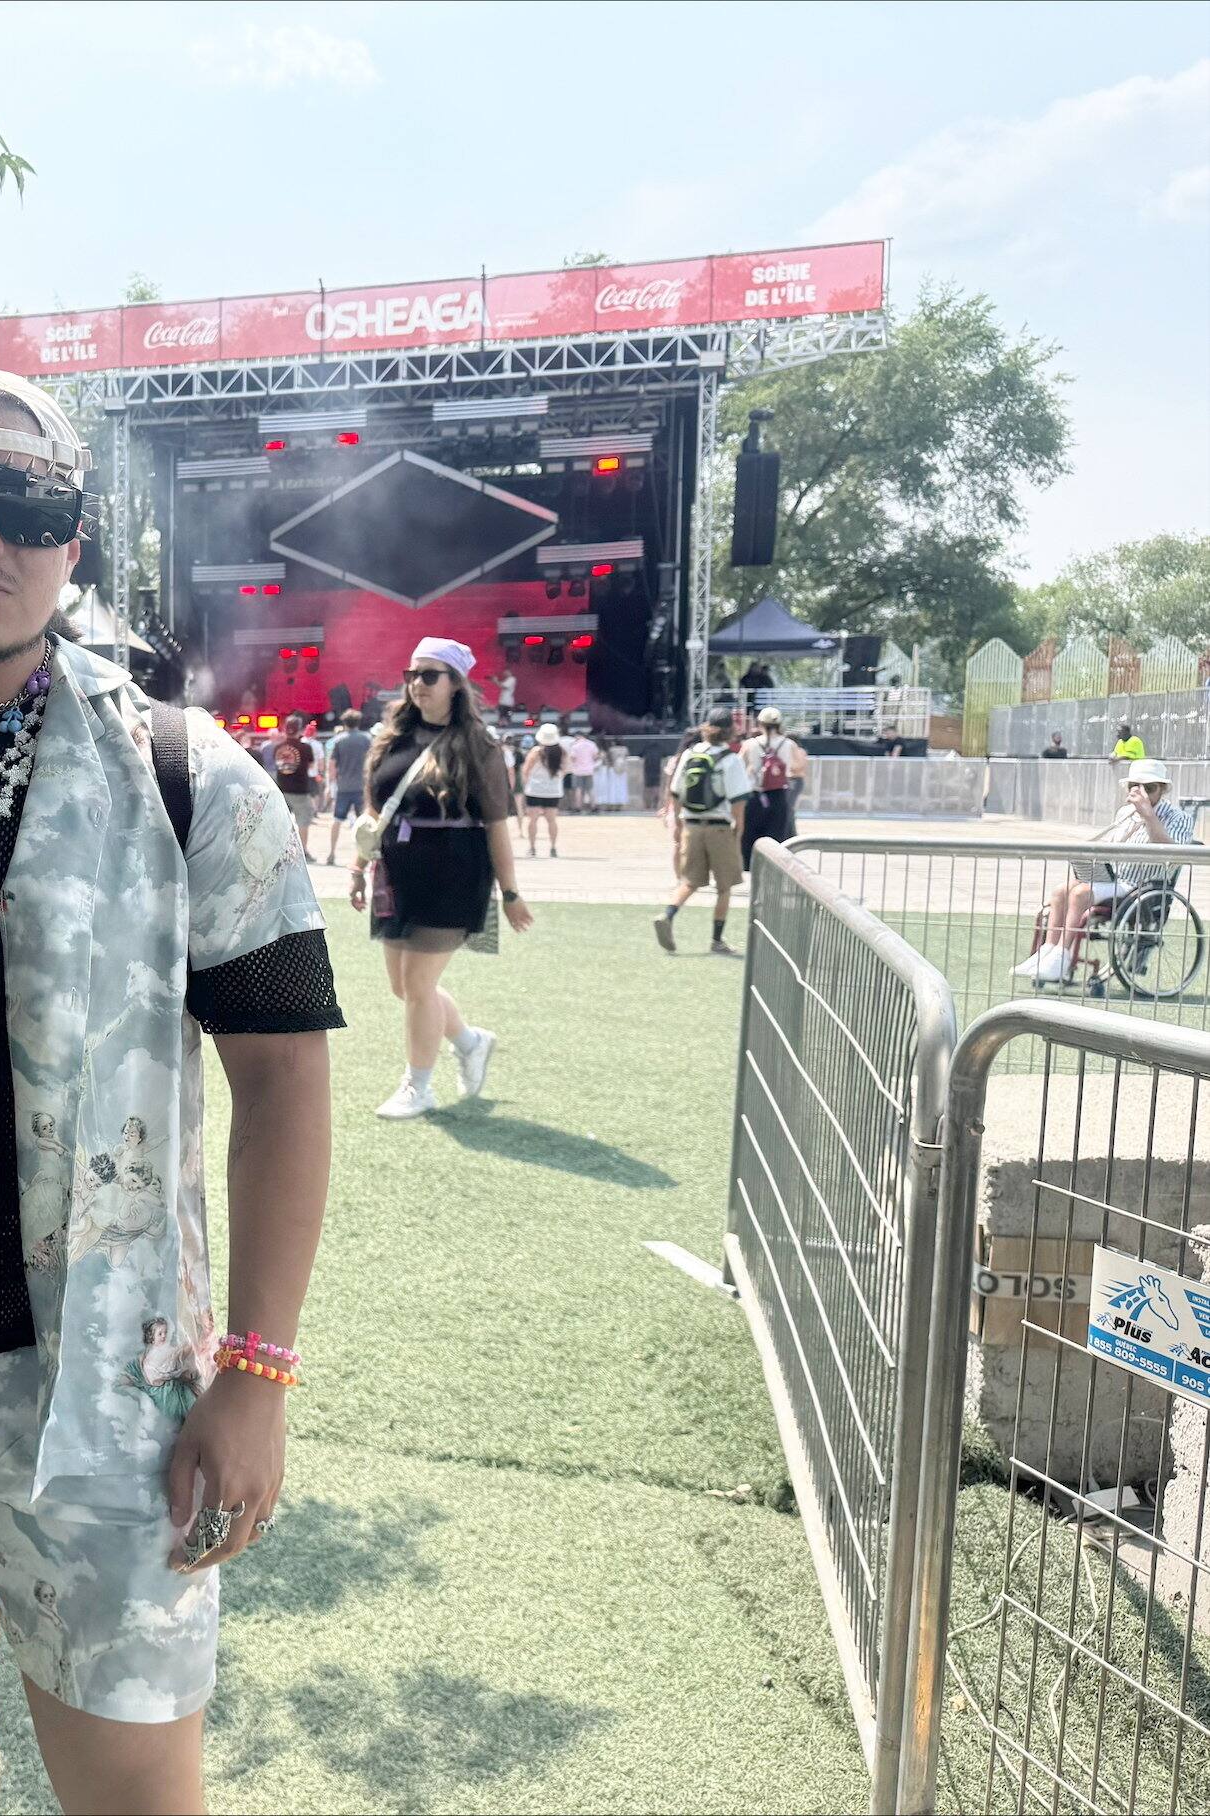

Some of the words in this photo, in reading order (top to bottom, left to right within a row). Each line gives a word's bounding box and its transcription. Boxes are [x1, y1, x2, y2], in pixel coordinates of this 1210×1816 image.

[751, 261, 811, 284] SCÈNE
[744, 289, 769, 307] DE
[771, 282, 817, 305] L'ÎLE
[305, 290, 491, 341] OSHEAGA
[45, 321, 92, 343] SCÈNE
[41, 347, 60, 363] DE
[1114, 1316, 1152, 1343] Plus
[1093, 1337, 1113, 1353] 855
[1114, 1347, 1168, 1376] 809-5555
[1181, 1374, 1205, 1392] 905
